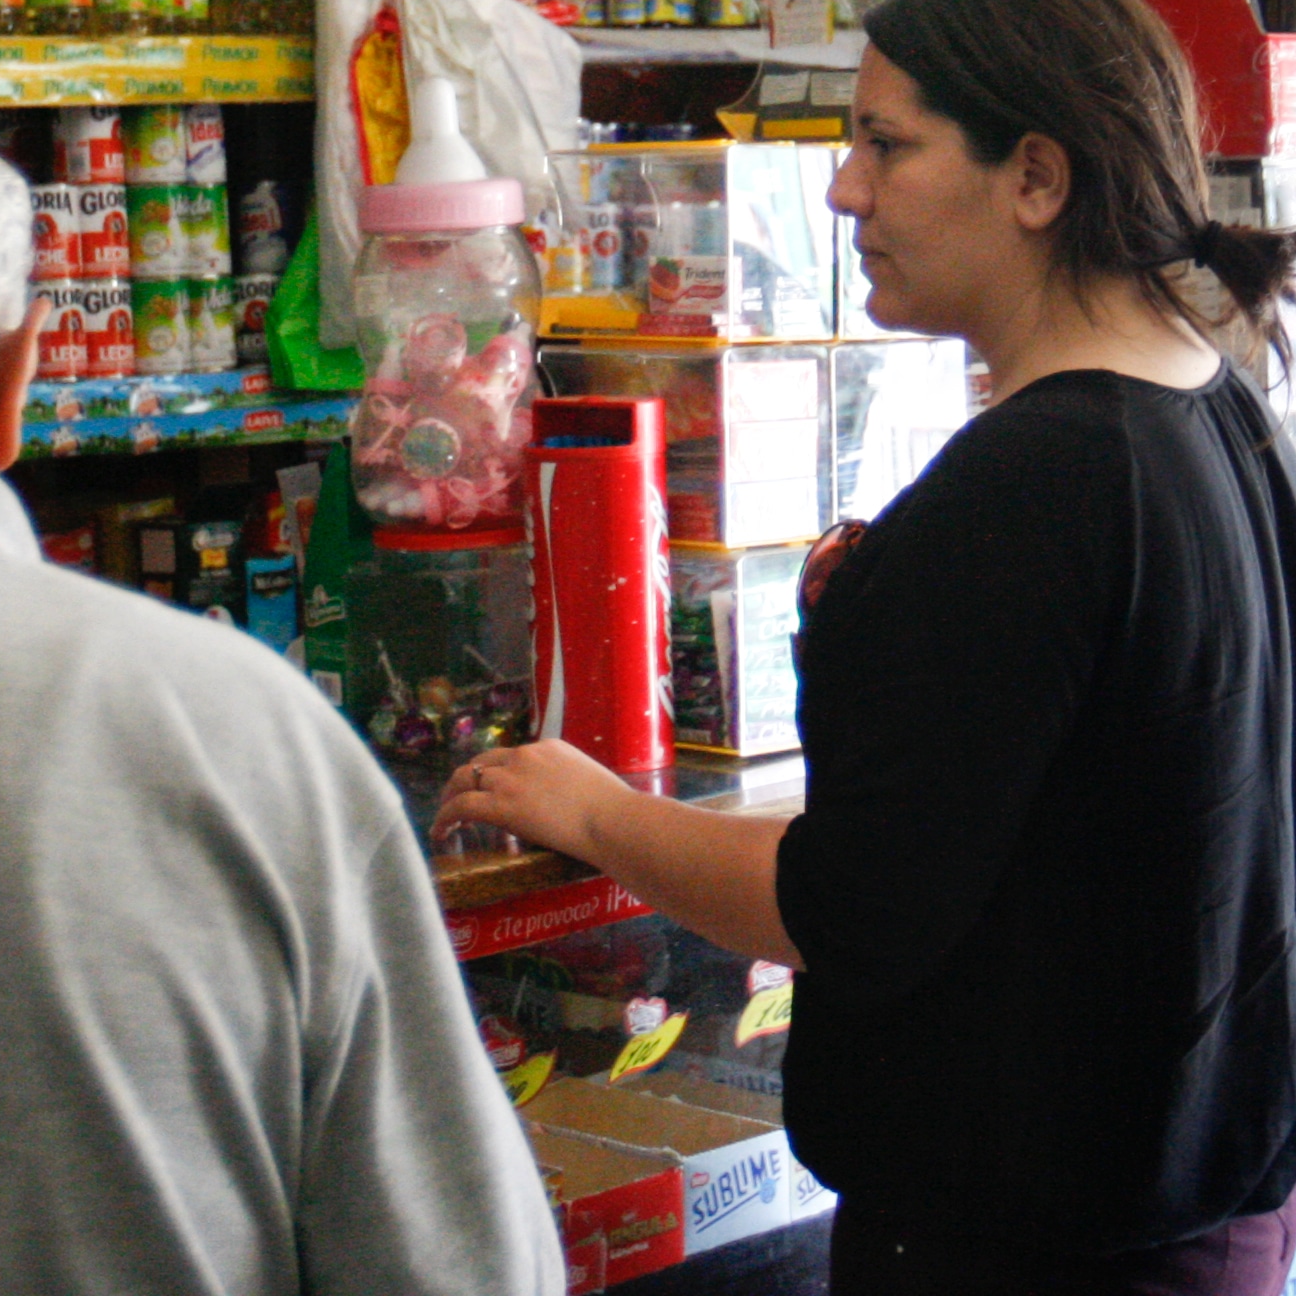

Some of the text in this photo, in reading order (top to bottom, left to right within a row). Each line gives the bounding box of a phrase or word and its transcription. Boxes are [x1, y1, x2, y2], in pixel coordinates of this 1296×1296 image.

[685, 264, 726, 281] Trident
[493, 915, 523, 941] ¿Te
[525, 895, 600, 939] provoca?
[691, 1149, 781, 1226] SUBLIME
